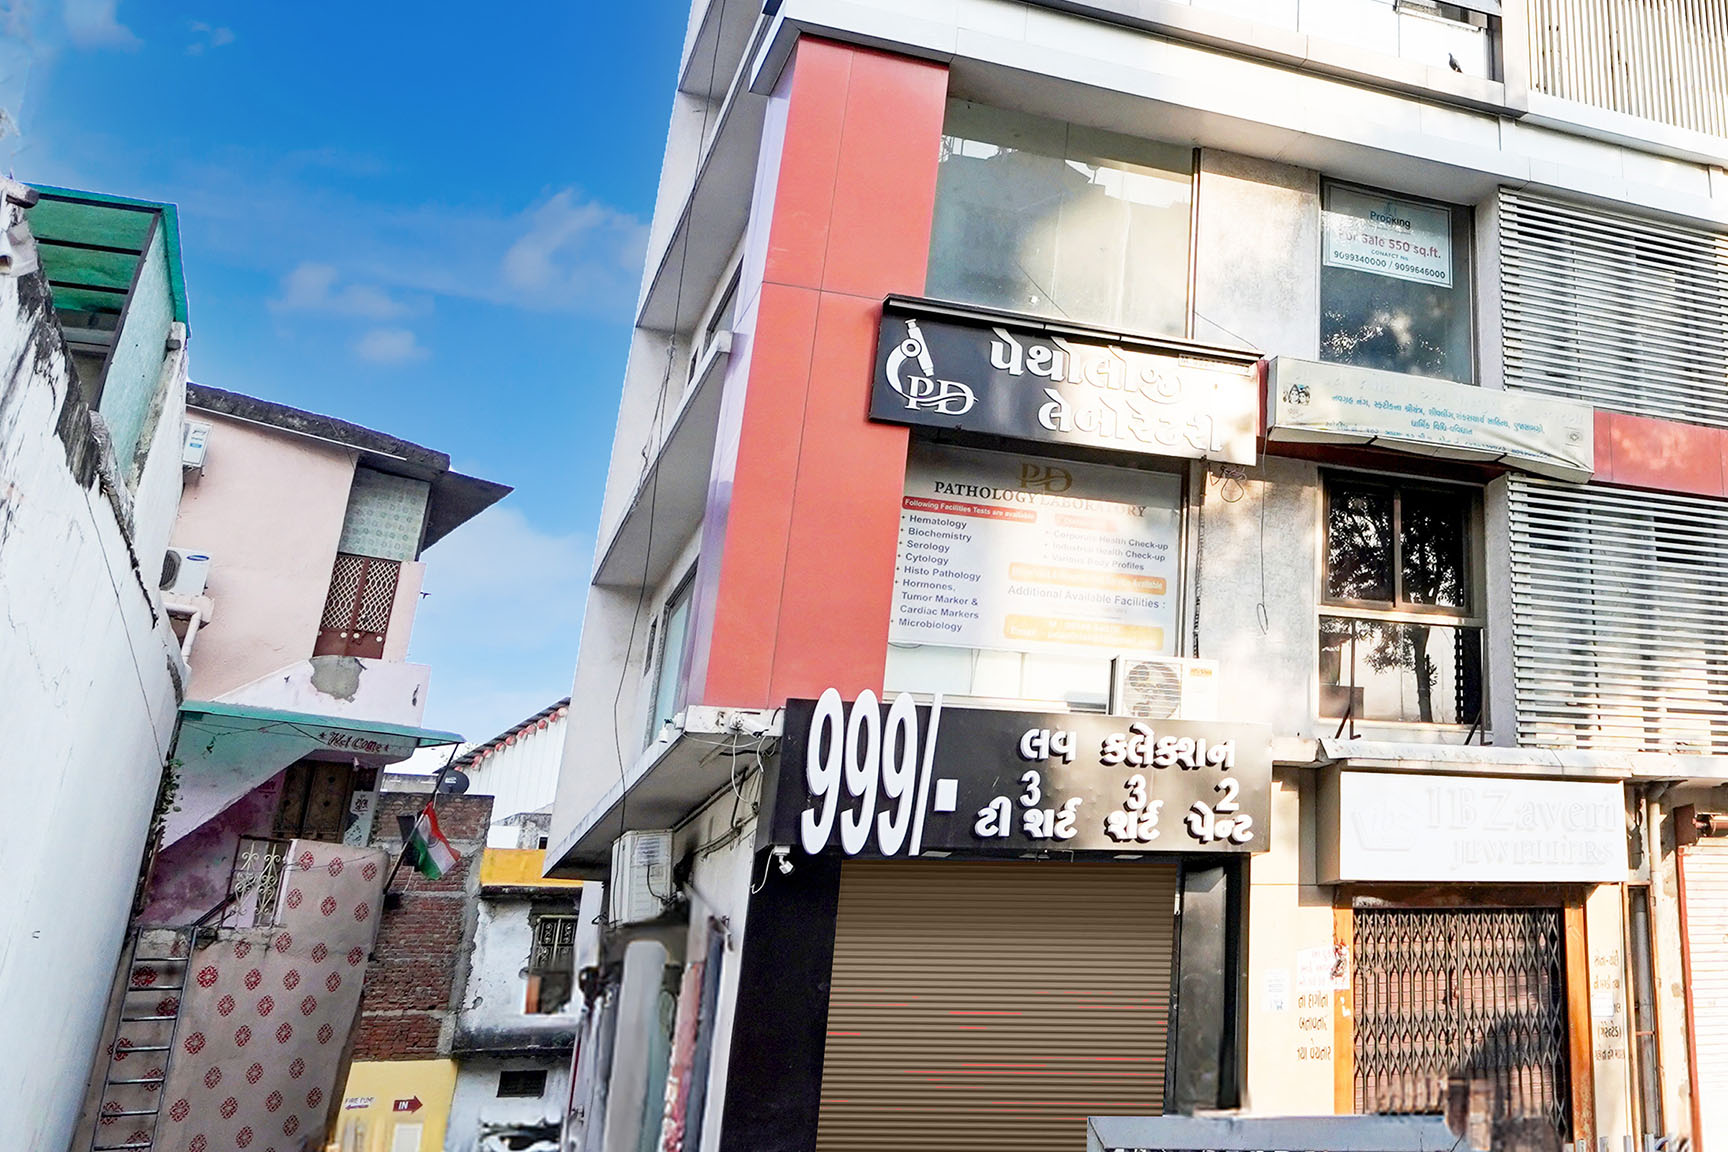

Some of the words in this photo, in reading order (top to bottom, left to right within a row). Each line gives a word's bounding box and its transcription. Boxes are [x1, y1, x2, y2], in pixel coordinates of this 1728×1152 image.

[1362, 233, 1385, 248] Sale
[1389, 239, 1410, 253] 550
[1413, 245, 1441, 259] sq.ft.
[1333, 250, 1387, 267] 9099340000
[990, 327, 1183, 405] પેથોલોજી
[934, 480, 1035, 505] PATHOLOGY
[904, 498, 939, 510] Following
[940, 502, 971, 513] Facilities
[973, 506, 991, 515] Tests
[909, 514, 967, 530] Hematology
[908, 527, 972, 543] Biochemistry
[906, 539, 950, 554] Serology
[1128, 538, 1169, 552] Check-up
[905, 552, 949, 566] Cytology
[1125, 550, 1166, 563] Check-up
[904, 565, 930, 576] Histo
[932, 568, 981, 582] Pathology
[1111, 560, 1145, 571] Profiles
[901, 591, 933, 602] Tumor
[935, 594, 968, 605] Marker
[971, 597, 979, 607] &
[1007, 584, 1062, 599] Additional
[1065, 591, 1112, 605] Available
[1113, 595, 1160, 609] Facilities
[900, 604, 938, 616] Cardiac
[940, 608, 979, 619] Markers
[898, 617, 963, 633] Microbiology
[1019, 728, 1076, 764] લવ
[801, 687, 959, 857] 999/-
[974, 796, 1011, 839] ટી
[1020, 797, 1083, 841] શર્ટ
[1103, 799, 1164, 843] શર્ટ
[1184, 801, 1254, 845] પેન્ટ
[398, 1101, 409, 1110] IN
